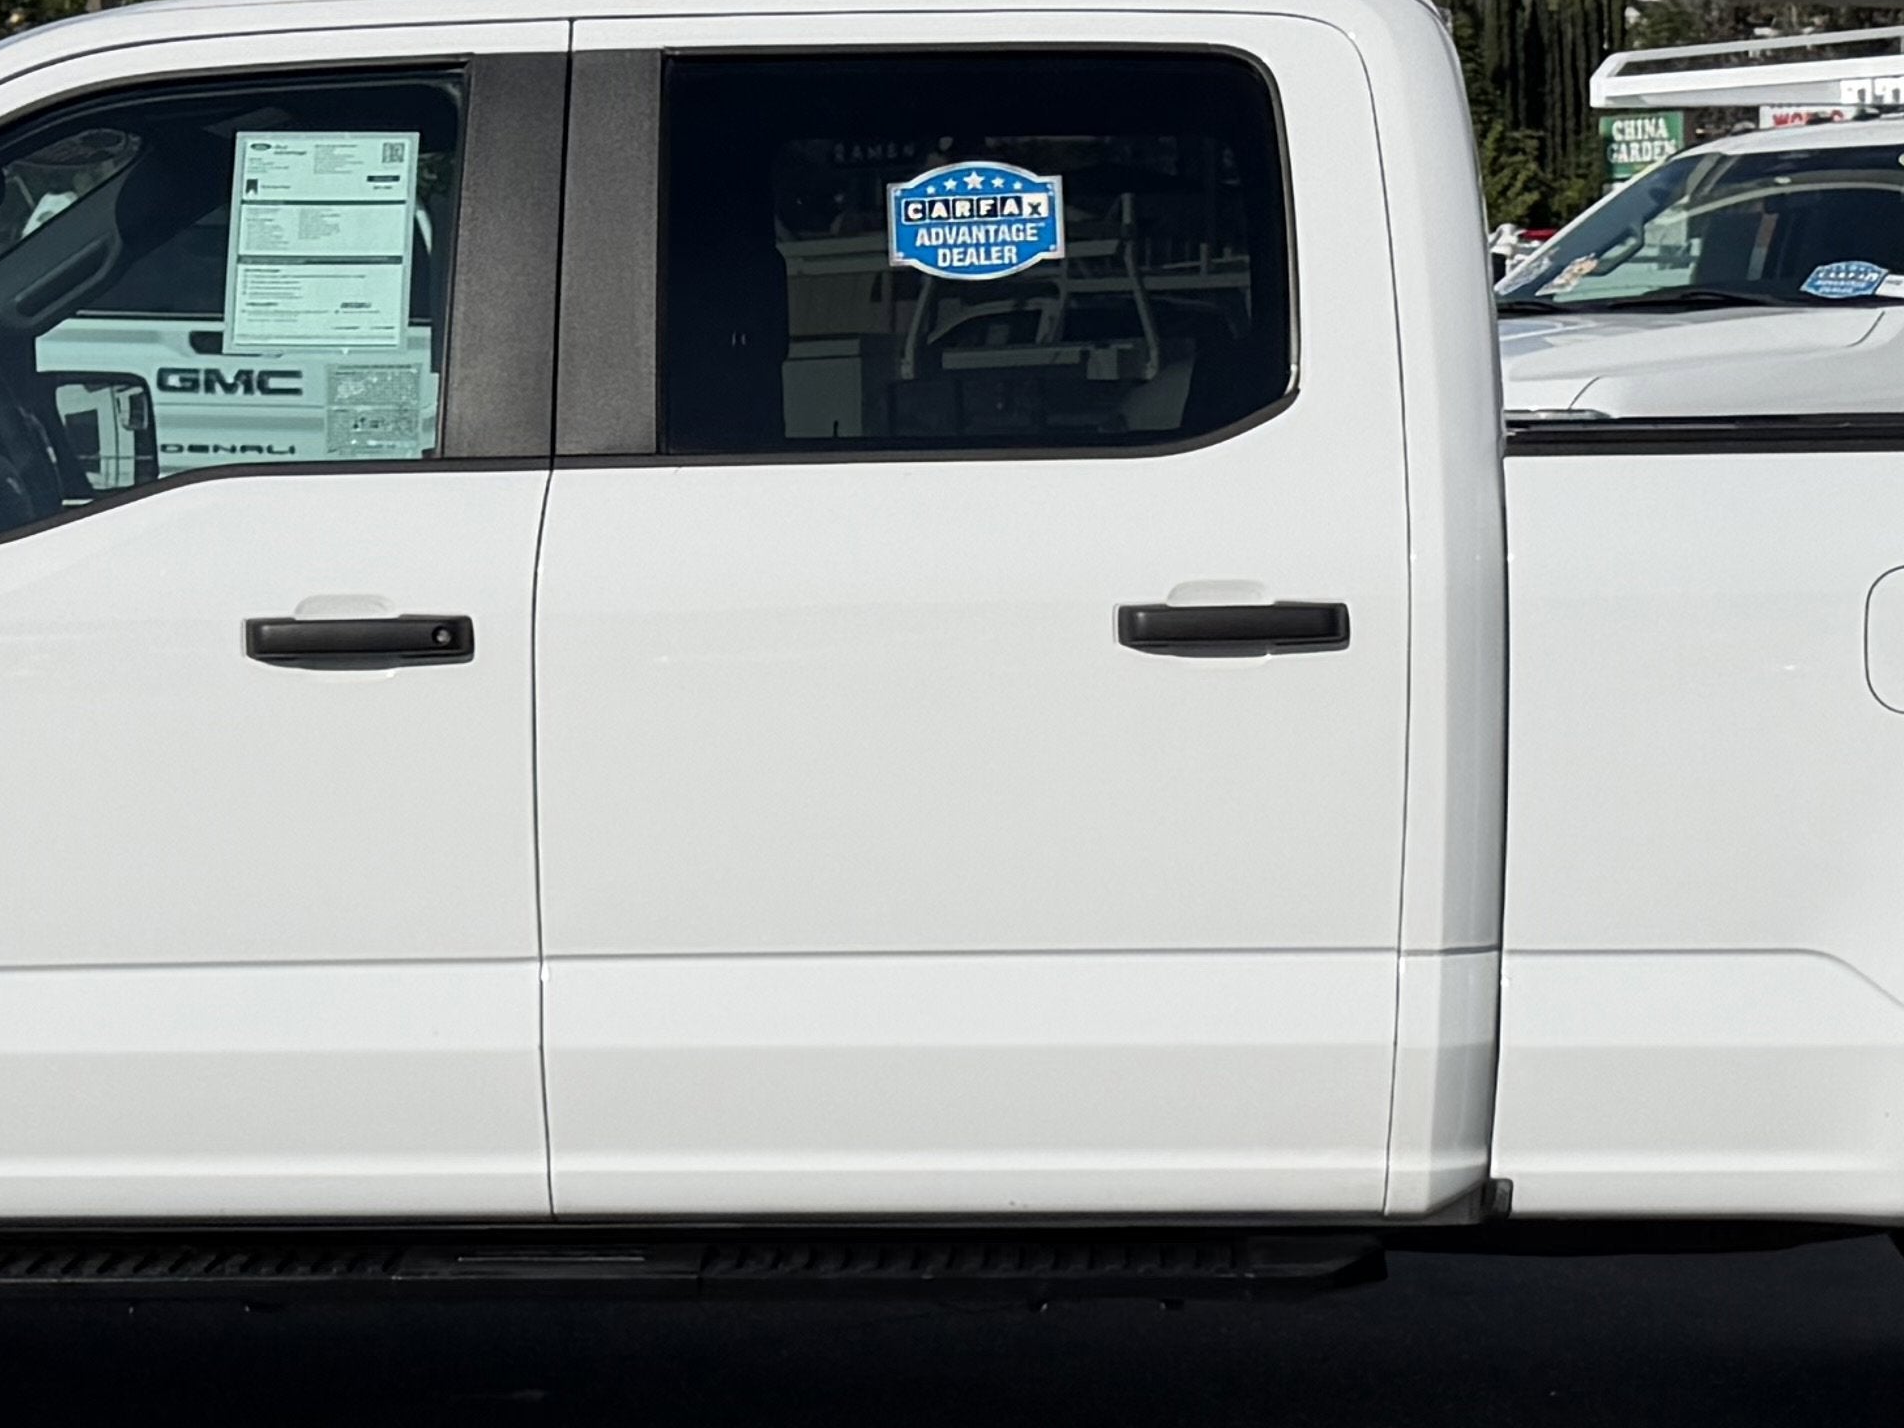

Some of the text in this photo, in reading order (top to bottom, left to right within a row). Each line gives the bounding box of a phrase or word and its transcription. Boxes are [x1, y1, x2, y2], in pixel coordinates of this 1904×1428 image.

[1611, 116, 1669, 141] CHINA
[905, 196, 1045, 221] CARFAX
[915, 225, 1038, 247] ADVANTAGE
[937, 245, 1018, 268] DEALER
[157, 367, 303, 395] GMC
